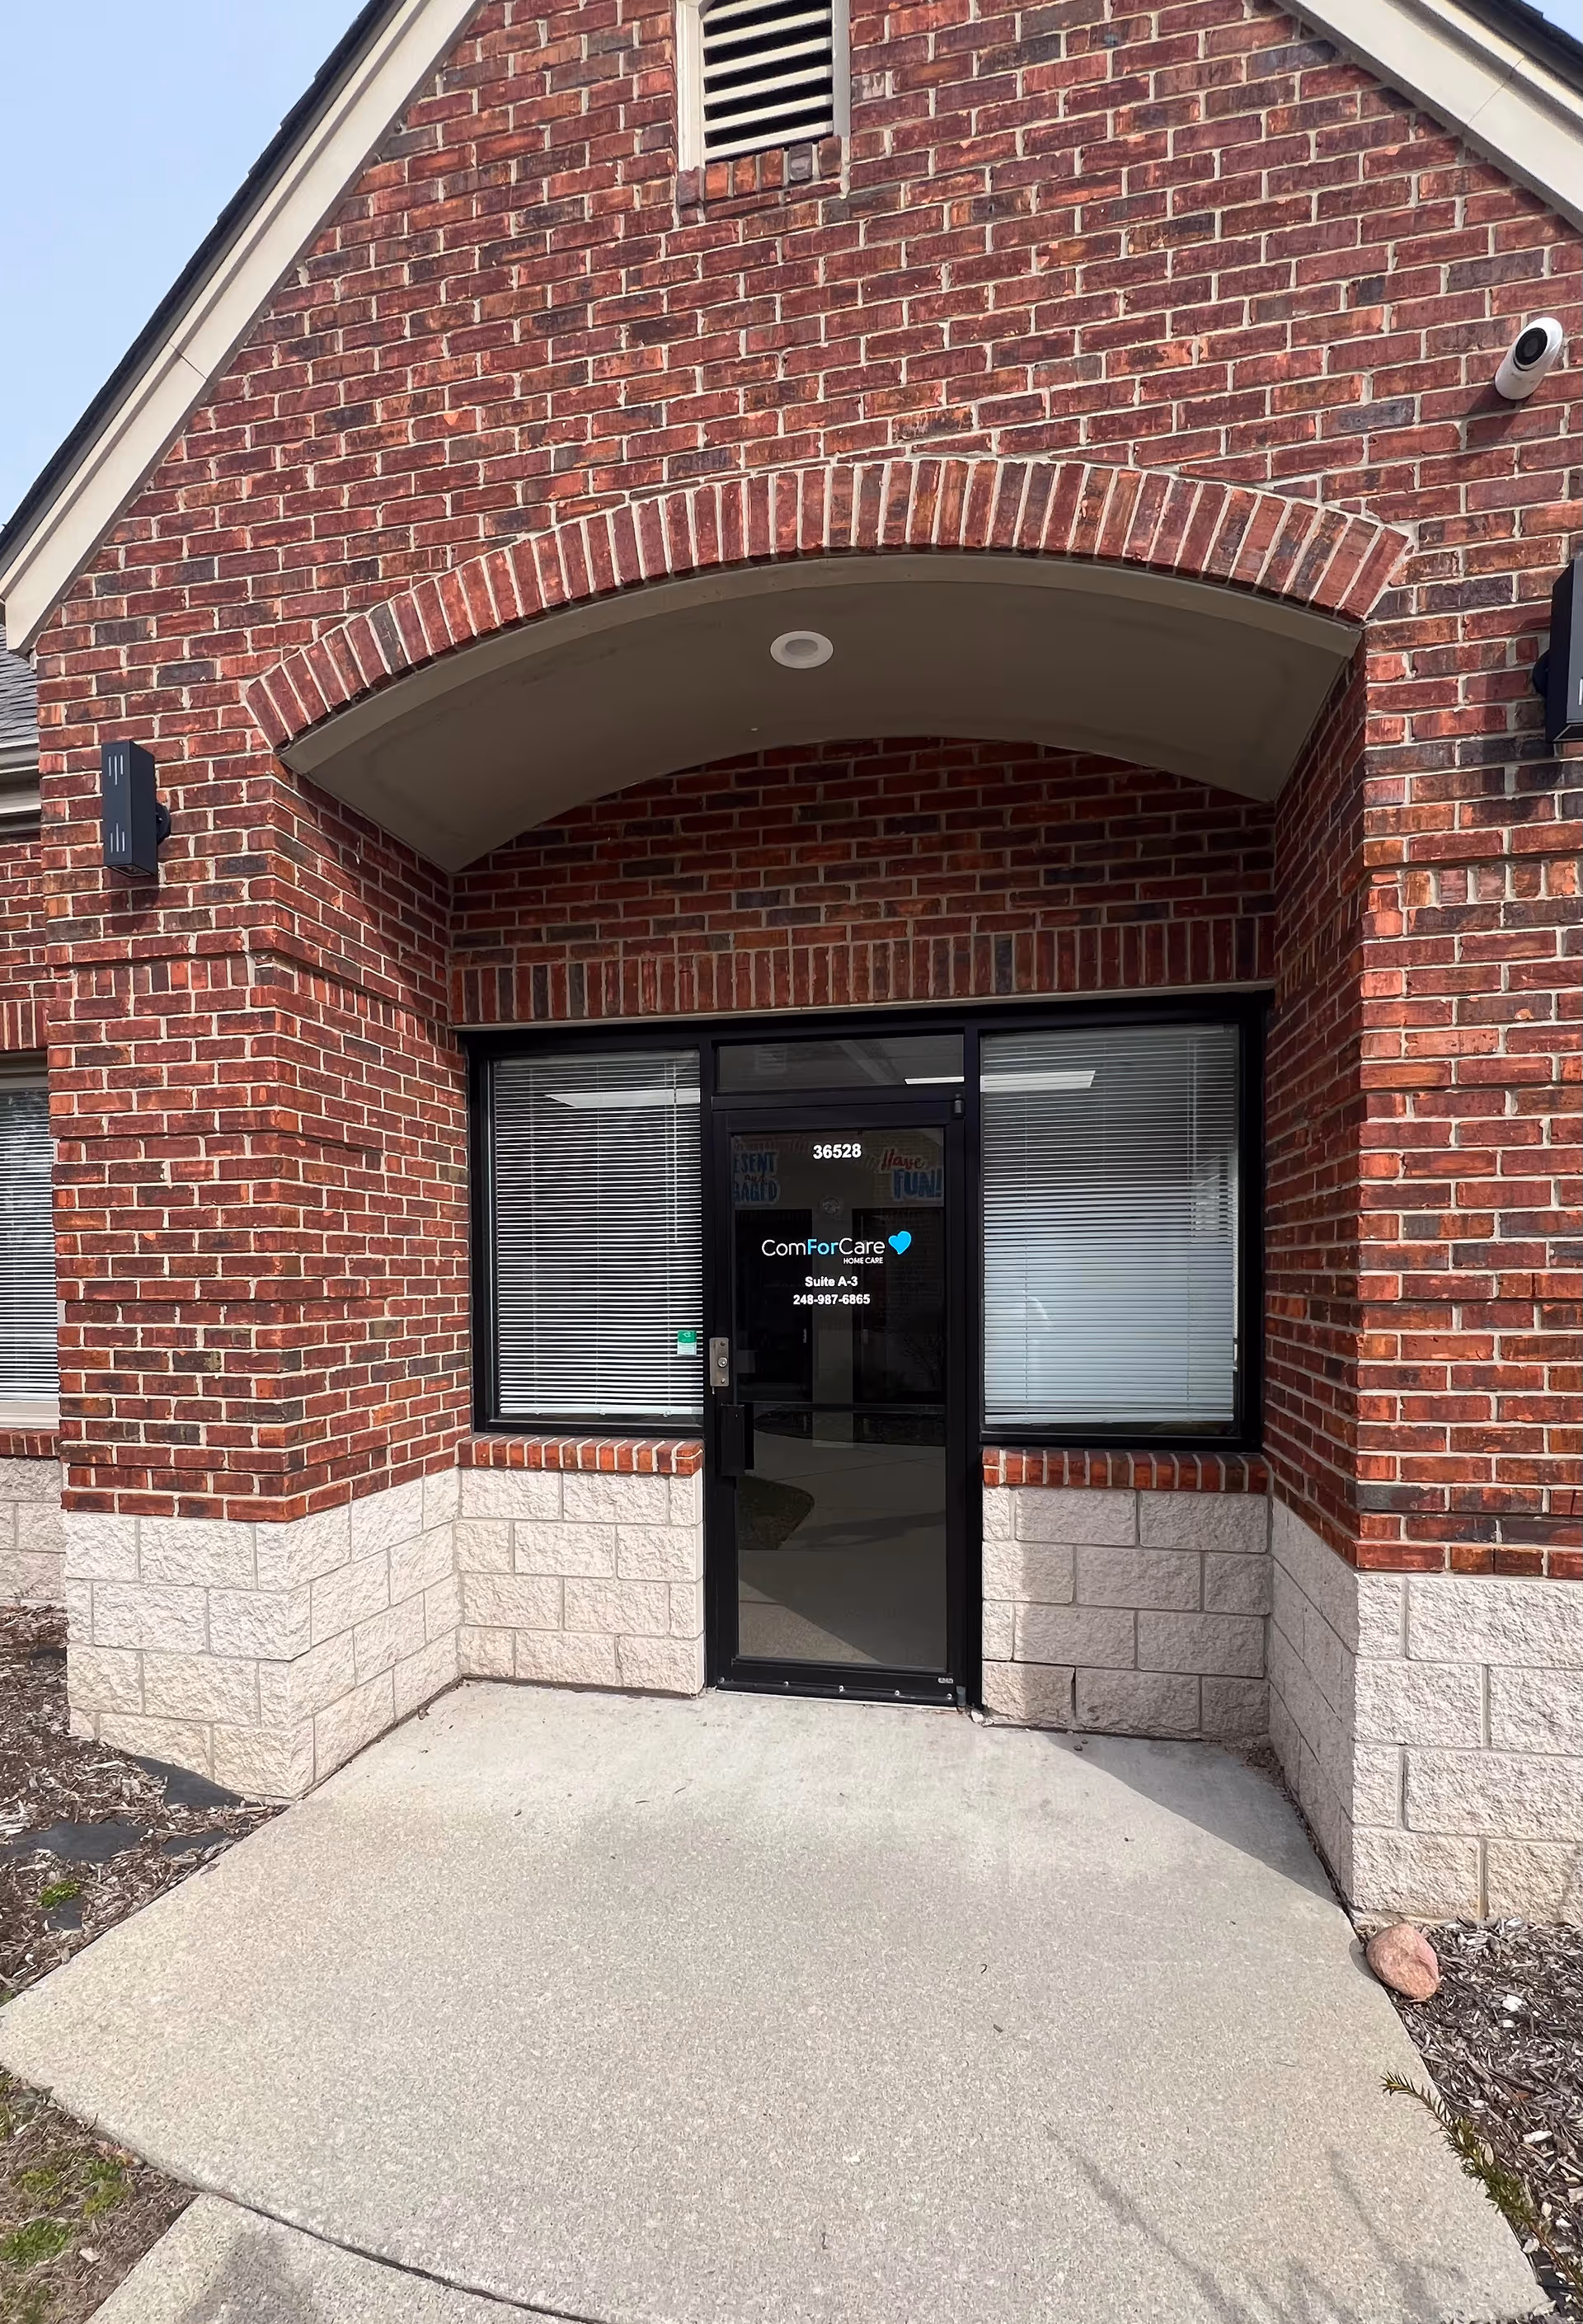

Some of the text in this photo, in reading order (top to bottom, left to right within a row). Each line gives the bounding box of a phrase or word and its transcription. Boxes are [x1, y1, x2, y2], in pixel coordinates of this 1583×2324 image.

[812, 1143, 862, 1159] 36528
[881, 1148, 924, 1171] Have
[894, 1168, 942, 1199] FUN!
[761, 1238, 885, 1256] ComForCare
[805, 1275, 858, 1287] Suite A-3
[792, 1293, 871, 1305] 248-987-6865
